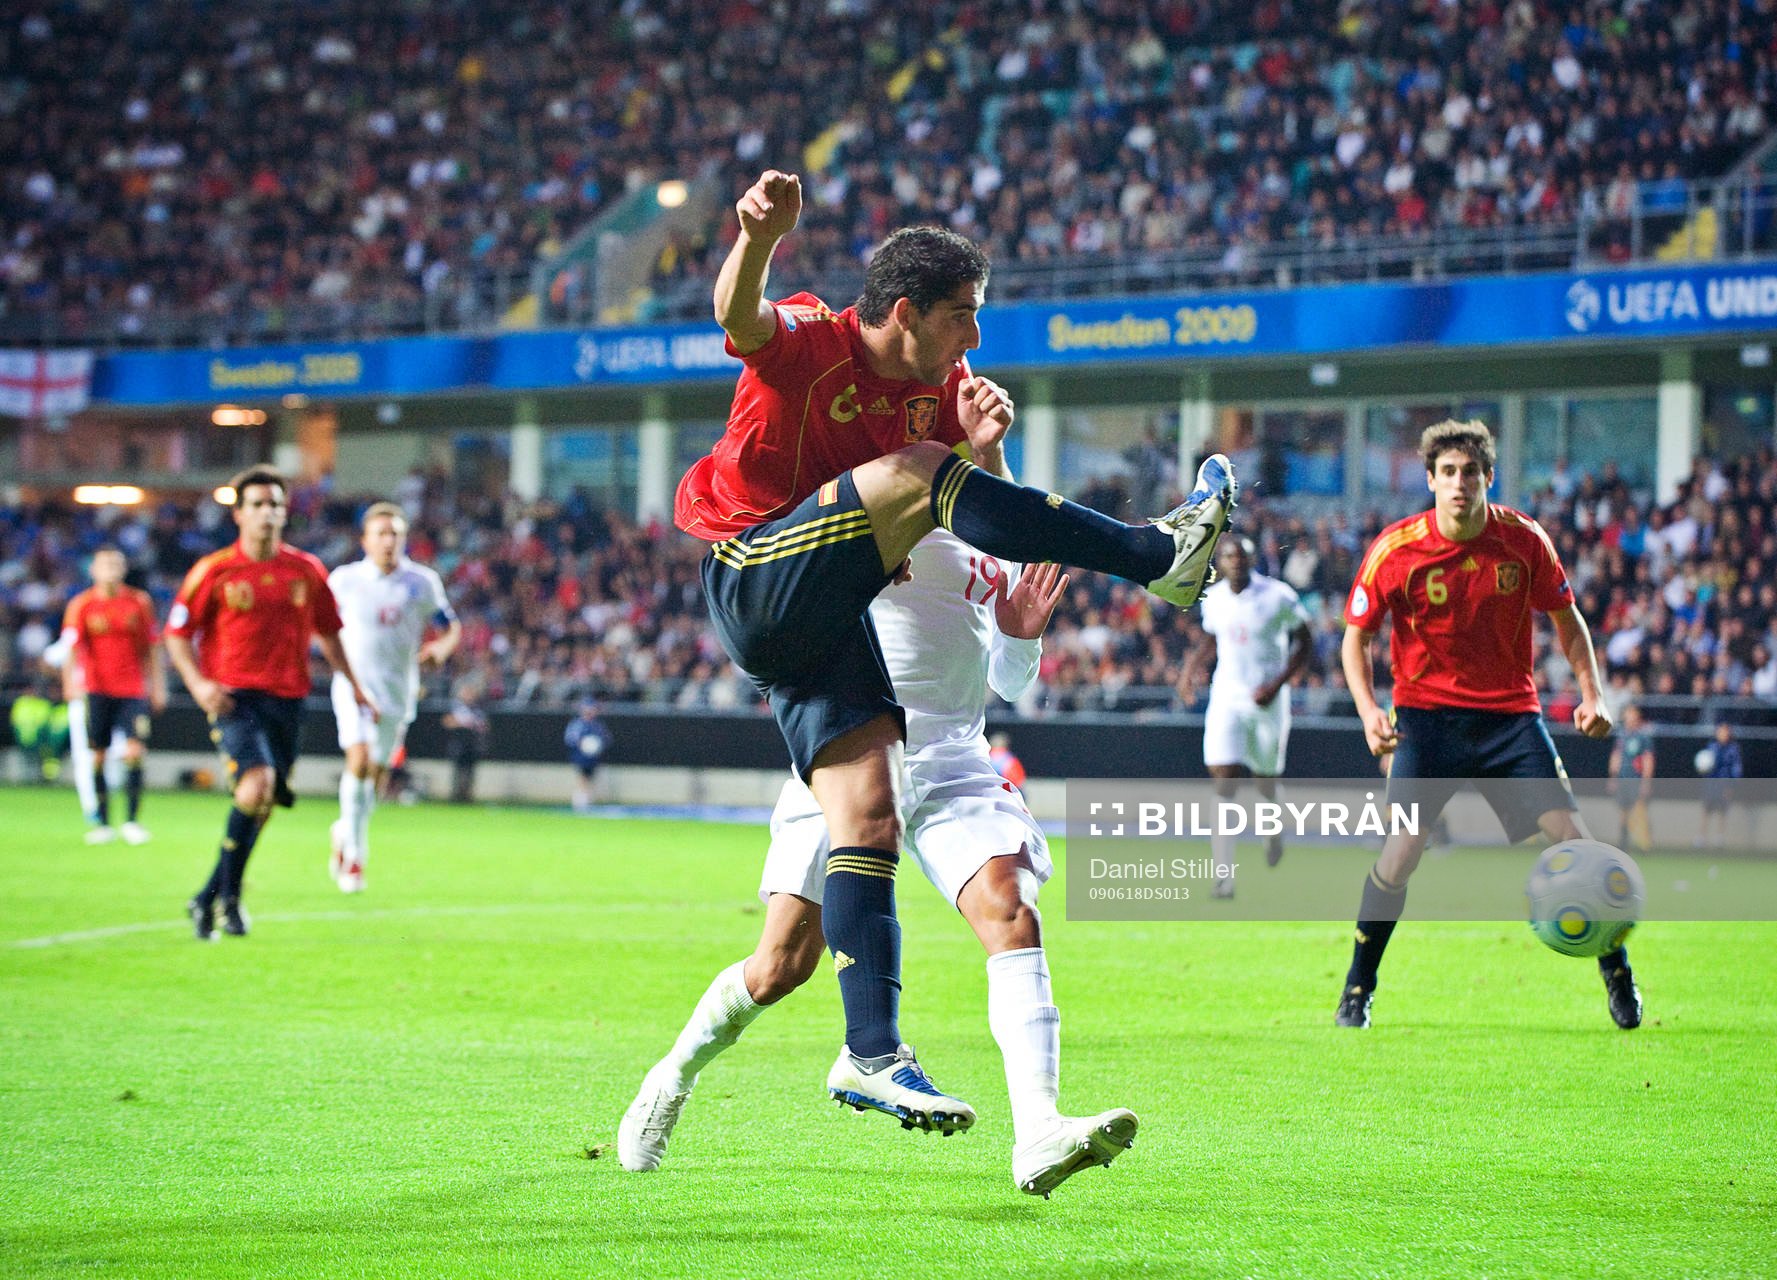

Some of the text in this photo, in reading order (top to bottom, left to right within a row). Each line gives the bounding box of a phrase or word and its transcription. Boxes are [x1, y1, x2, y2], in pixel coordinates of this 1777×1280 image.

[1608, 280, 1698, 323] UEFA
[1048, 304, 1257, 351] Sweden 2009
[965, 553, 1000, 605] 19
[1426, 567, 1448, 605] 6
